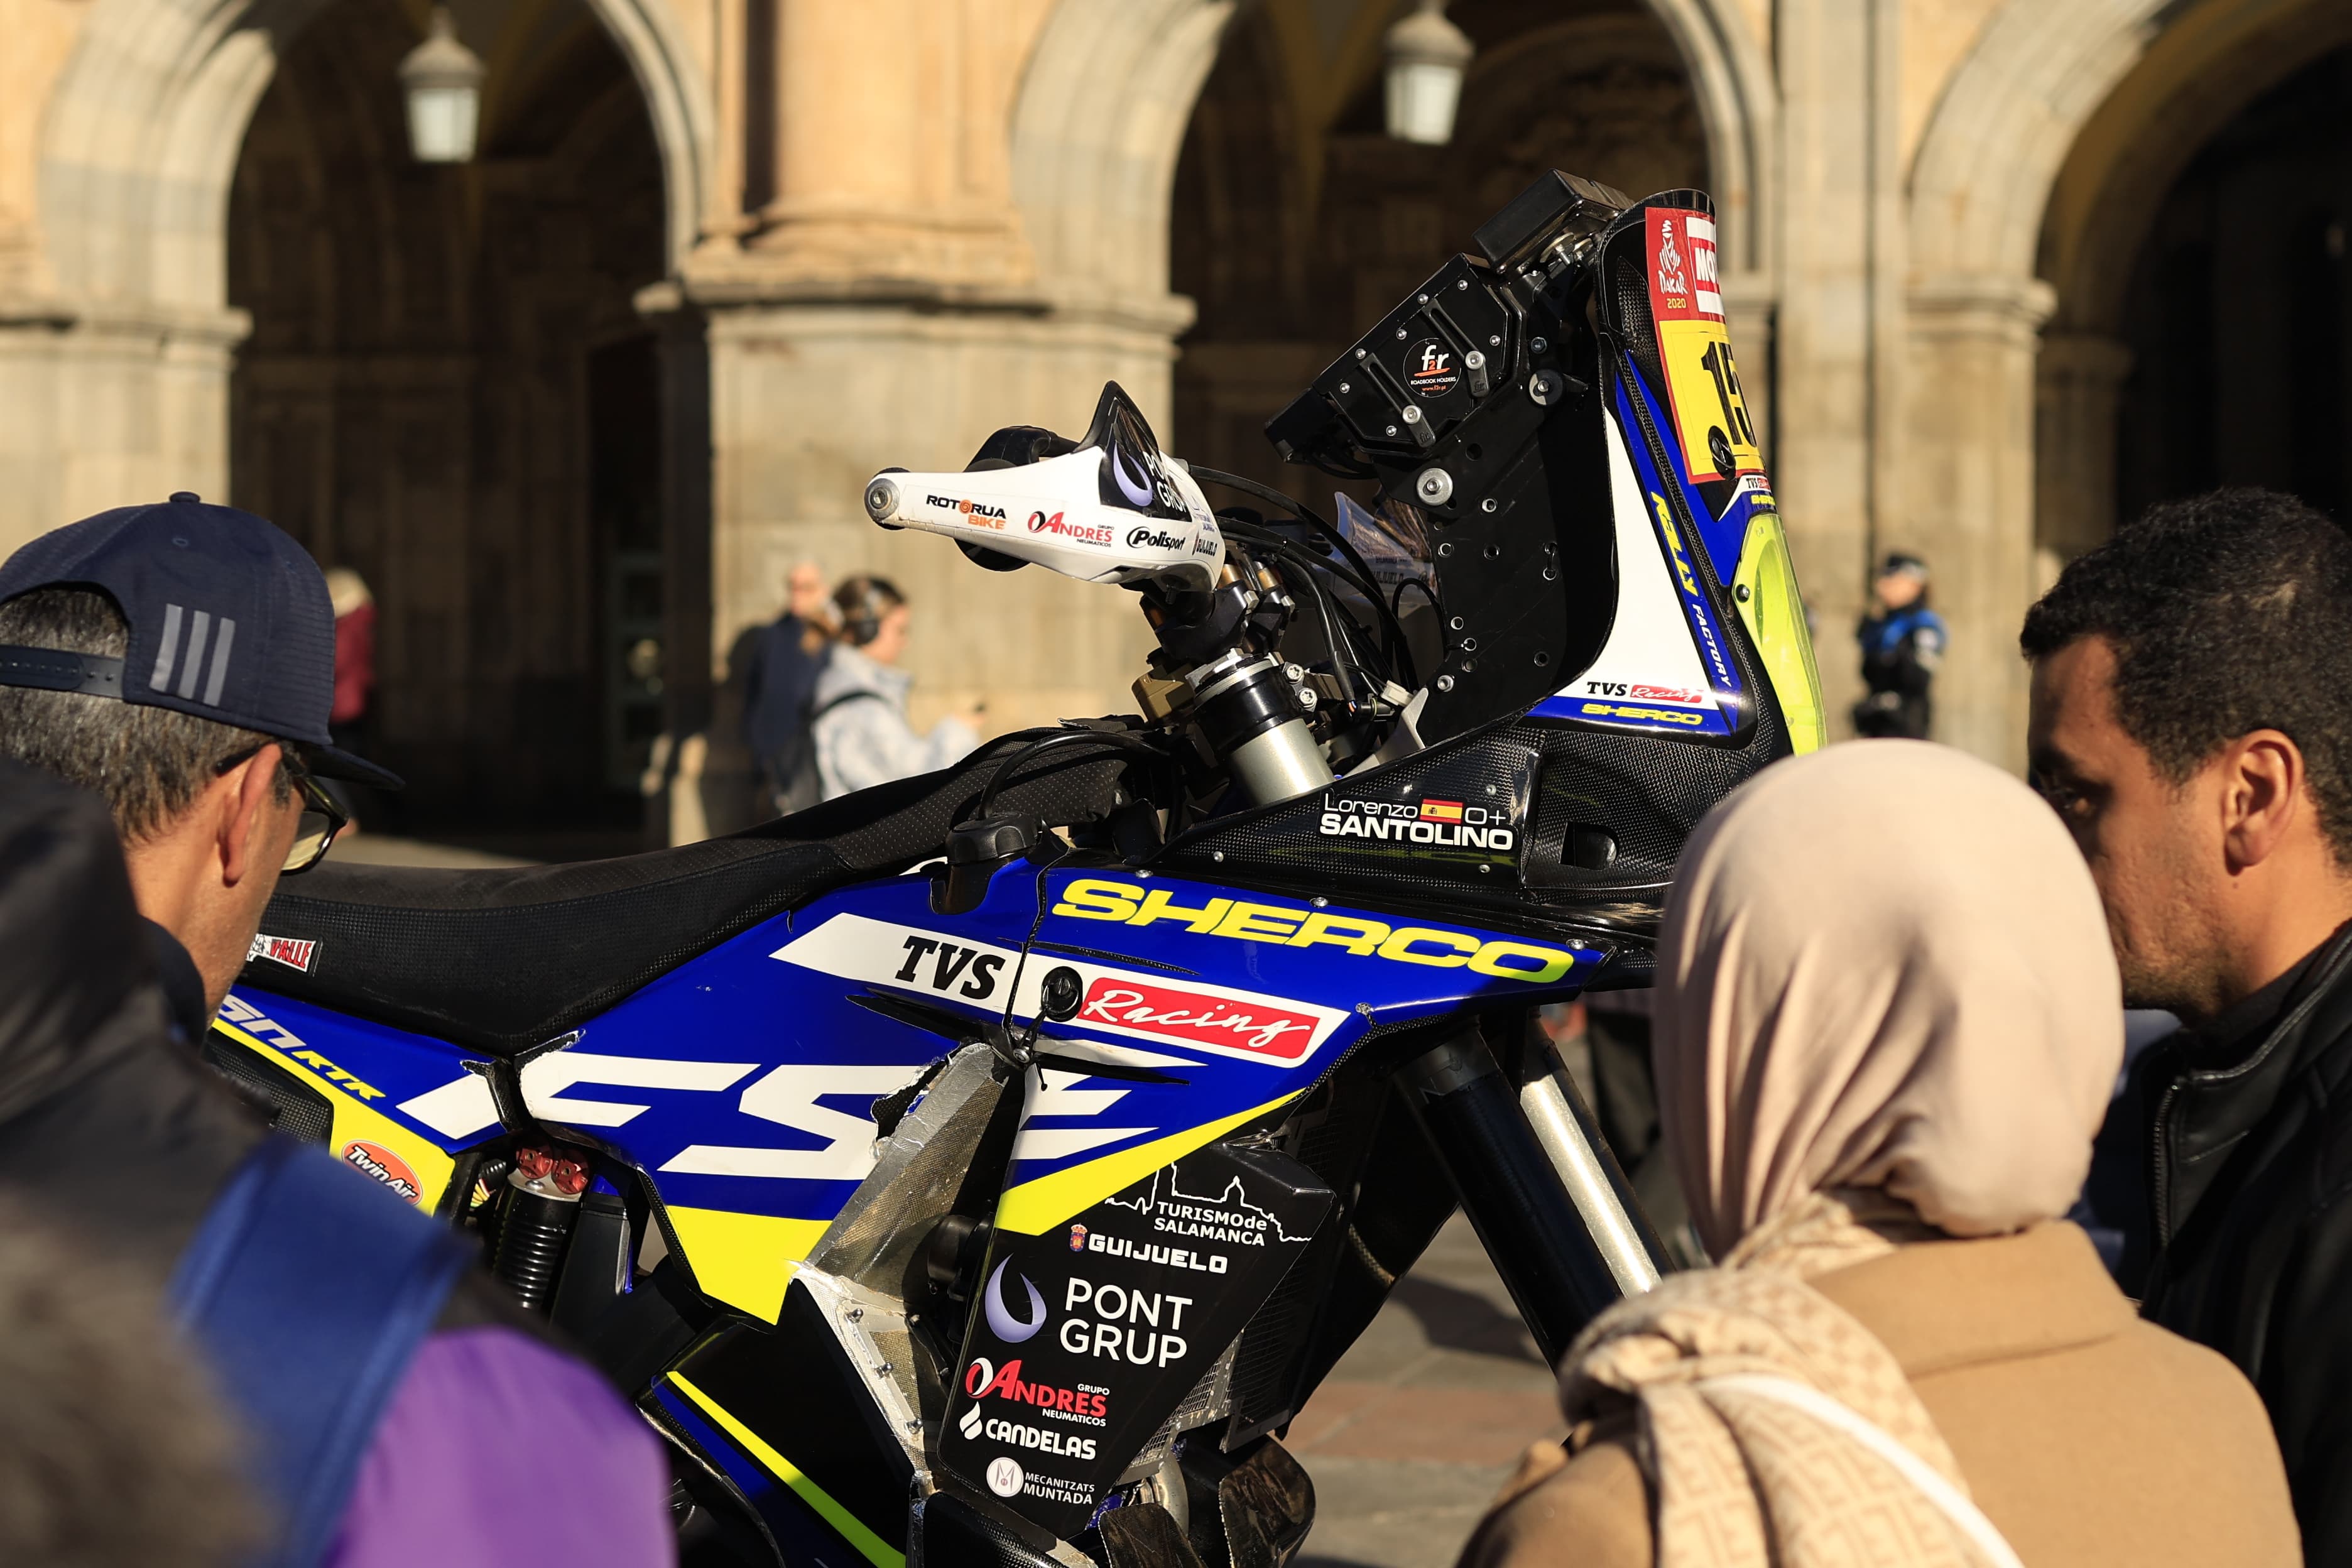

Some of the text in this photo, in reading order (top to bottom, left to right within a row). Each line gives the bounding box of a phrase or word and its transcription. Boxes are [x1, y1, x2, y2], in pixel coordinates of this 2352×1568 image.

[1658, 270, 1688, 295] DAKAR
[1667, 298, 1686, 309] 2020
[1746, 477, 1758, 488] TVS
[926, 494, 1006, 519] ROTORUA
[967, 514, 1006, 530] BIKE
[1131, 530, 1186, 551] Polisport
[1692, 603, 1732, 687] FACTORY
[1587, 682, 1696, 702] TVS Racing
[1582, 703, 1703, 725] SHERCO
[1324, 793, 1418, 819] Lorenzo
[1320, 813, 1513, 850] SANTOLINO
[1052, 878, 1574, 984] SHERCO
[270, 939, 312, 969] VALLE
[895, 935, 1311, 1048] TVS Racing
[347, 1145, 418, 1198] Twin Air
[1154, 1217, 1266, 1246] SALAMANCA
[1088, 1233, 1228, 1274] GUIJUELO
[1065, 1277, 1193, 1331] PONT
[1060, 1319, 1187, 1368] GRUP
[1077, 1383, 1110, 1395] GRUPO
[1042, 1408, 1106, 1427] NEUMATICOS
[986, 1418, 1096, 1460] CANDELAS
[1023, 1483, 1093, 1505] MUNTADA
[1025, 1472, 1095, 1493] MECANITZATS
